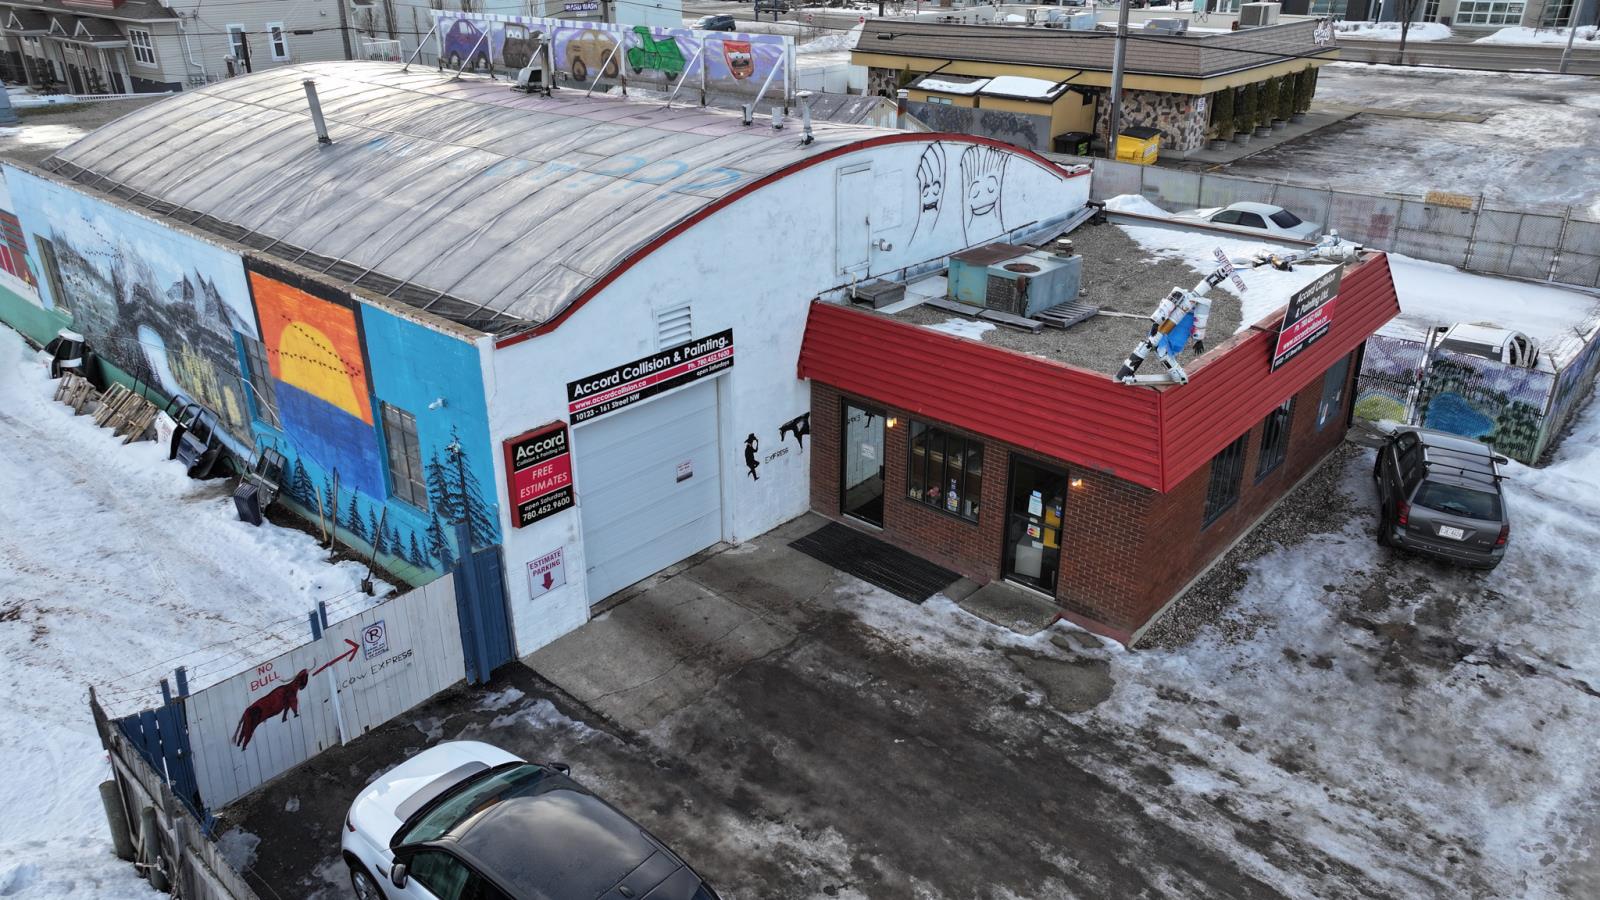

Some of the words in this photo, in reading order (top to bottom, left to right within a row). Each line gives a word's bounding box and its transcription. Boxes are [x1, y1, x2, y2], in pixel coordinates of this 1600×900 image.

[1214, 249, 1235, 274] SUPER
[1296, 284, 1316, 305] Accord
[1315, 273, 1336, 292] Collision
[1295, 307, 1300, 318] &
[1300, 296, 1320, 315] Painting
[574, 371, 620, 397] Accord
[622, 356, 671, 380] Collision
[673, 351, 682, 363] &
[696, 368, 709, 376] open
[575, 380, 647, 410] www.accordcollision.ca
[576, 408, 595, 421] 10123
[600, 404, 610, 413] 161
[611, 397, 629, 409] Street
[629, 393, 640, 403] NW
[516, 431, 565, 460] Accord
[516, 456, 536, 467] Collision
[540, 448, 558, 458] Painting
[532, 464, 554, 480] FREE
[520, 472, 568, 498] ESTIMATES
[522, 496, 570, 521] 780.452.9600
[524, 501, 540, 511] open
[540, 490, 567, 505] Saturdays
[529, 550, 561, 570] ESTIMATE
[532, 559, 561, 577] PARKING
[256, 662, 274, 676] NO
[342, 671, 367, 689] COW
[370, 649, 413, 675] EXPRESS
[250, 671, 280, 691] BULL
